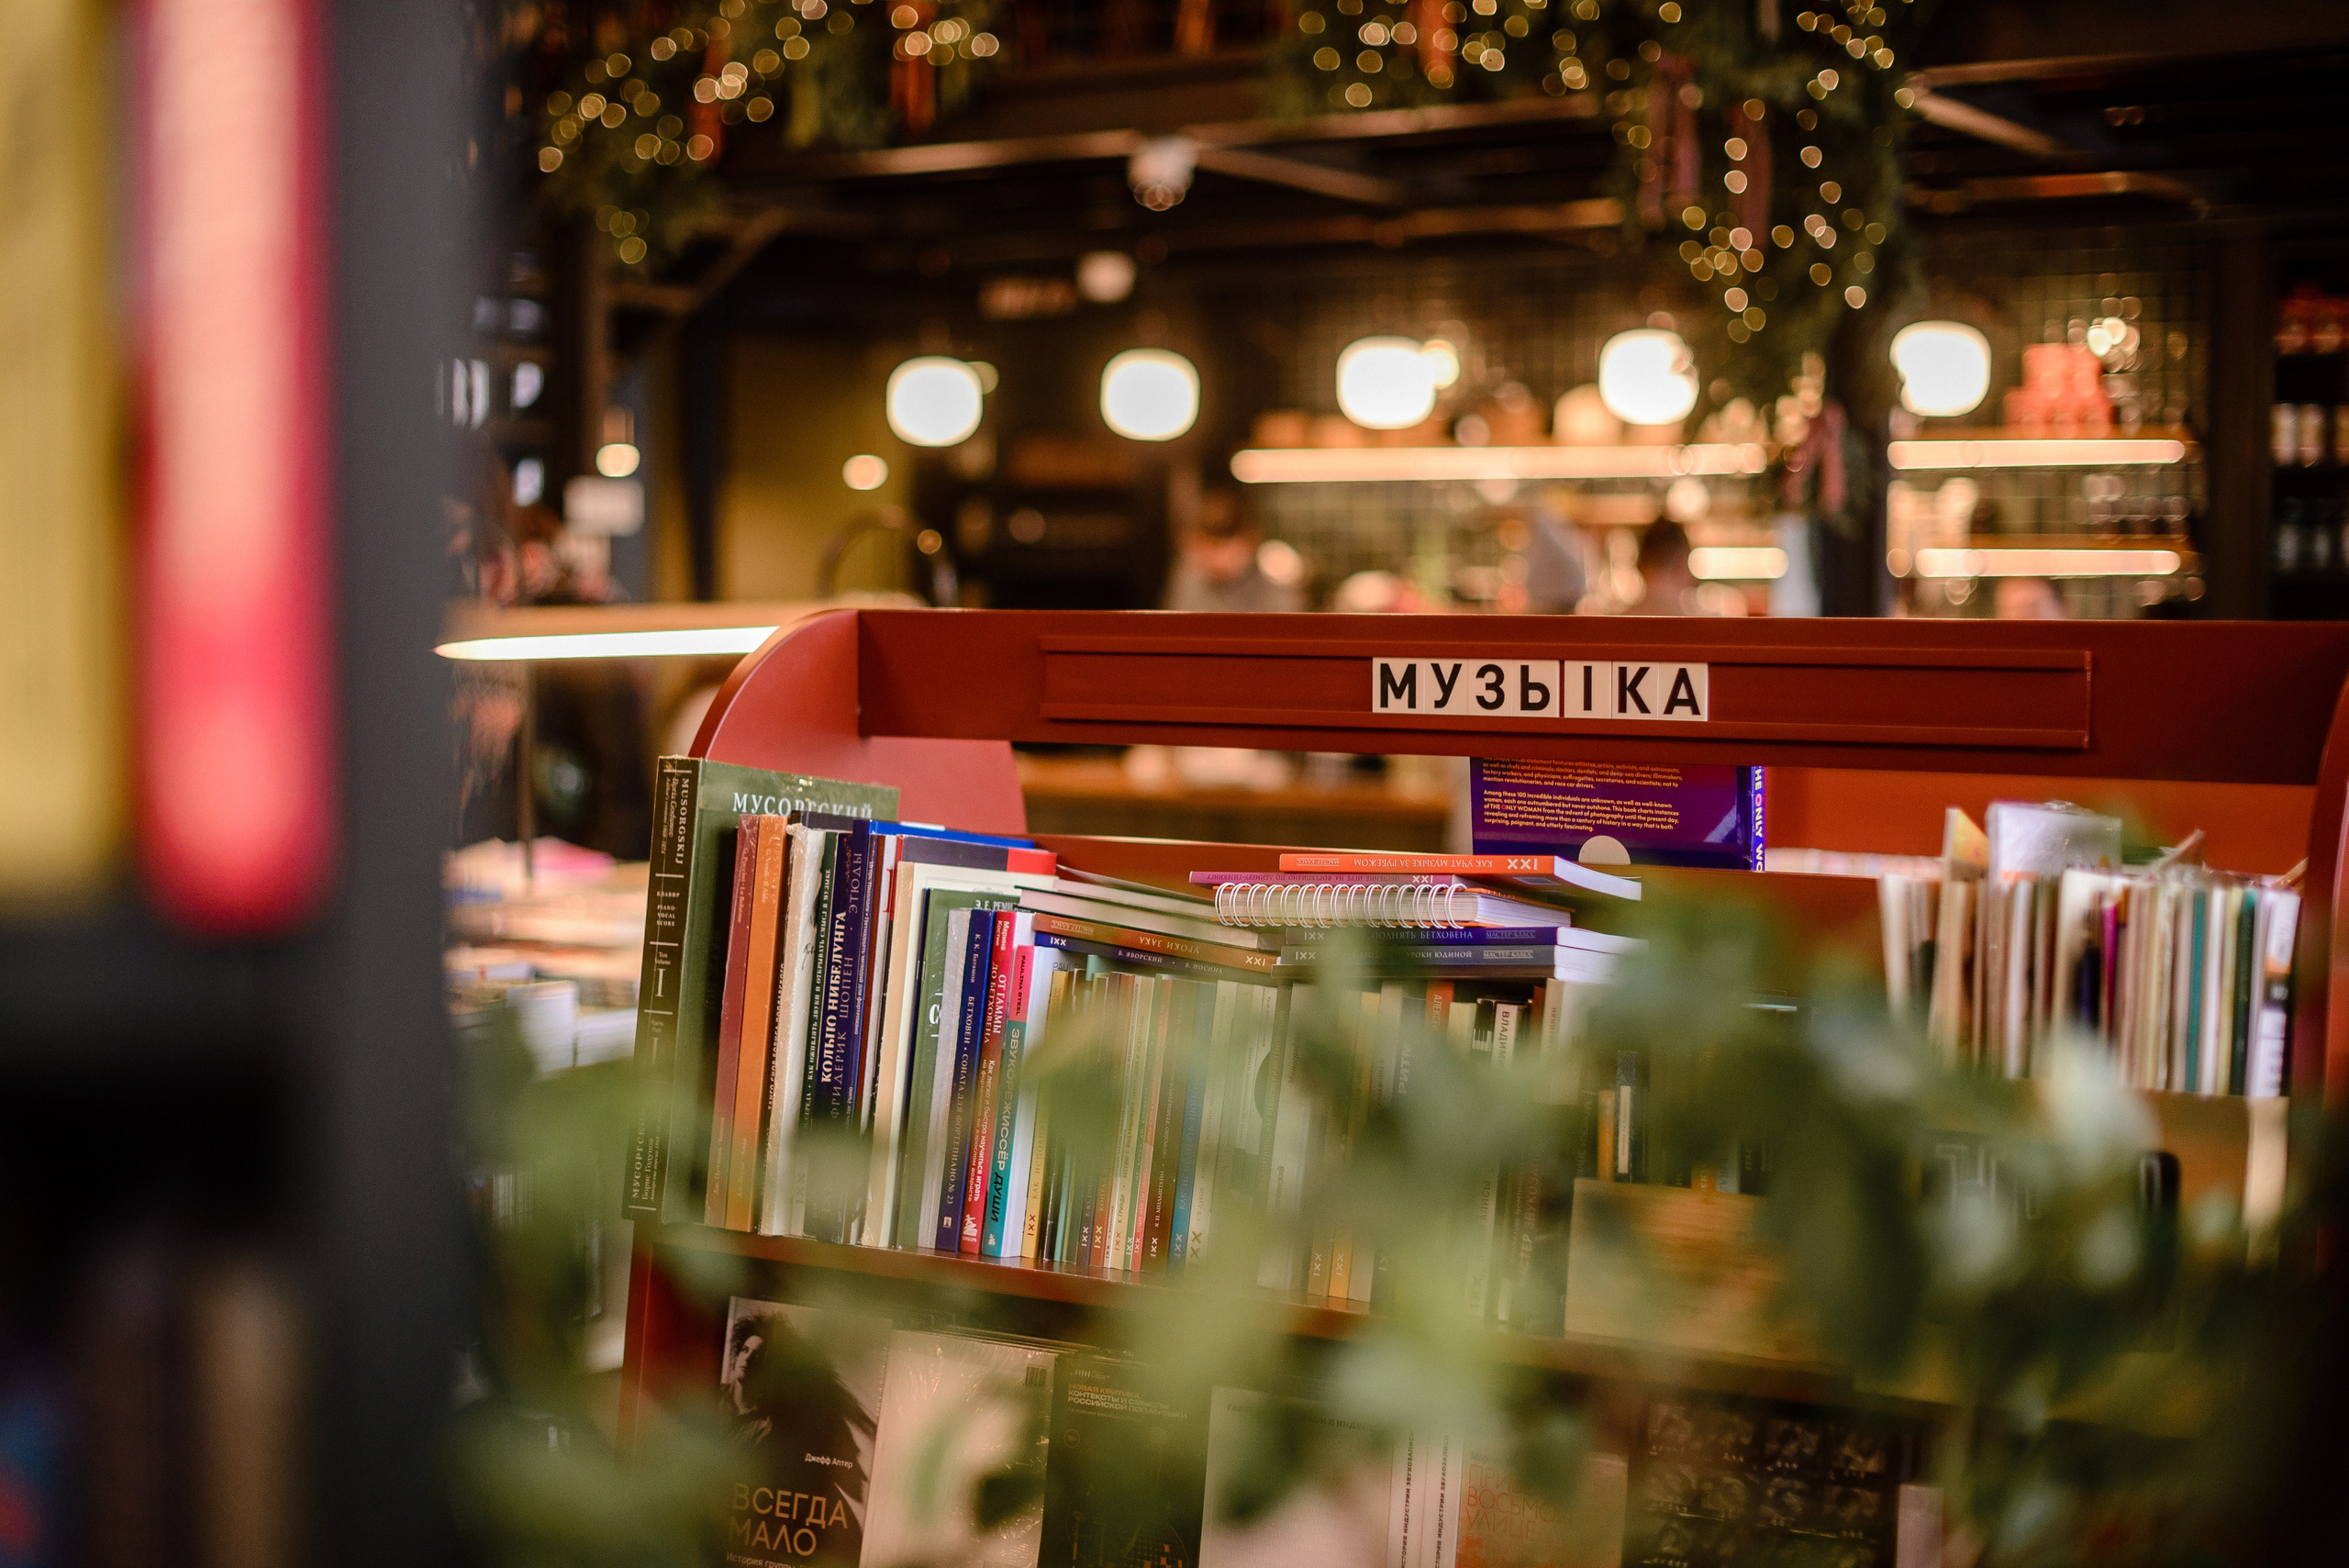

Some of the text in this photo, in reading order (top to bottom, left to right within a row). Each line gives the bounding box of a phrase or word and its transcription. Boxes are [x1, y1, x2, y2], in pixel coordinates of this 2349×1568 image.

[1379, 662, 1701, 716] МУЗЫКА
[1504, 777, 1542, 786] revolutionaries,
[1484, 789, 1502, 798] Among
[1527, 792, 1552, 800] incredible
[1590, 797, 1615, 806] unknown,
[1642, 801, 1672, 809] well-known
[1527, 800, 1561, 808] outnumbered
[675, 777, 690, 864] MUSORGSKIJ
[1484, 810, 1508, 818] revealing
[1519, 813, 1544, 821] reframing
[1576, 817, 1596, 825] century
[1602, 818, 1620, 828] history
[1564, 823, 1594, 832] fascinating.
[1590, 812, 1624, 820] photography
[1667, 817, 1679, 825] day,
[1353, 858, 1397, 868] РУБЕЖОМ
[1399, 859, 1410, 868] ЗА
[1412, 859, 1448, 869] МУЗЫКЕ
[1450, 859, 1474, 869] УЧАТ
[1475, 859, 1493, 869] КАК
[823, 869, 831, 900] МУЗЫКЕ
[1275, 873, 1286, 882] ПО
[1288, 873, 1331, 882] ФОРТЕПИАНО
[1366, 874, 1400, 883] ОБУЧЕНИЕ
[1000, 920, 1010, 951] Марина
[1420, 930, 1474, 940] БЕТХОВЕНА
[1139, 936, 1200, 954] ЗАКА УРОКИ
[1434, 949, 1473, 959] ЮДИНОЙ
[816, 940, 825, 984] ОТКРЫВАТЬ
[1126, 951, 1223, 974] ЯВОРСКИЙ НОСИНА
[829, 1029, 847, 1120] ФРИДЕРИК
[838, 956, 853, 1018] ШОПЕН
[848, 852, 863, 915] ЭТЮДЫ
[820, 910, 846, 1084] КОЛЬЦО НИБЕЛУНГА
[983, 962, 998, 1044] ДО БЕТХОВЕНА
[992, 973, 1008, 1035] ОТ ГАММЫ
[812, 995, 820, 1020] ЗВУКИ
[809, 1021, 818, 1063] ОЖИВЛЯТЬ
[807, 1064, 815, 1081] КАК
[986, 1060, 996, 1074] Как
[946, 996, 975, 1206] БЕТХОВЕН СОНАТА ДЛЯ ФОРТЕПИАНО 23
[980, 1106, 991, 1134] быстро
[990, 1028, 1020, 1223] ЗВУКОРЕЖИССЁР ДУШИ
[975, 1135, 987, 1174] научиться
[967, 1166, 975, 1202] возрасте
[973, 1175, 983, 1202] играть
[1178, 1192, 1187, 1210] КАК
[1068, 1384, 1099, 1394] НОВАЯ
[1068, 1390, 1119, 1404] КОНТЕКСТЫ
[1068, 1396, 1128, 1410] РОССИЙСКОЙ
[805, 1452, 853, 1470] Джефф Аптер
[1403, 1430, 1414, 1534] ИНДУСТРИИ ЗВУКОЗАПИСИ
[1437, 1435, 1449, 1539] ИНДУСТРИИ ЗВУКОЗАПИСИ
[733, 1482, 848, 1529] ВСЕГДА
[729, 1516, 817, 1556] МАЛО
[726, 1551, 763, 1566] История
